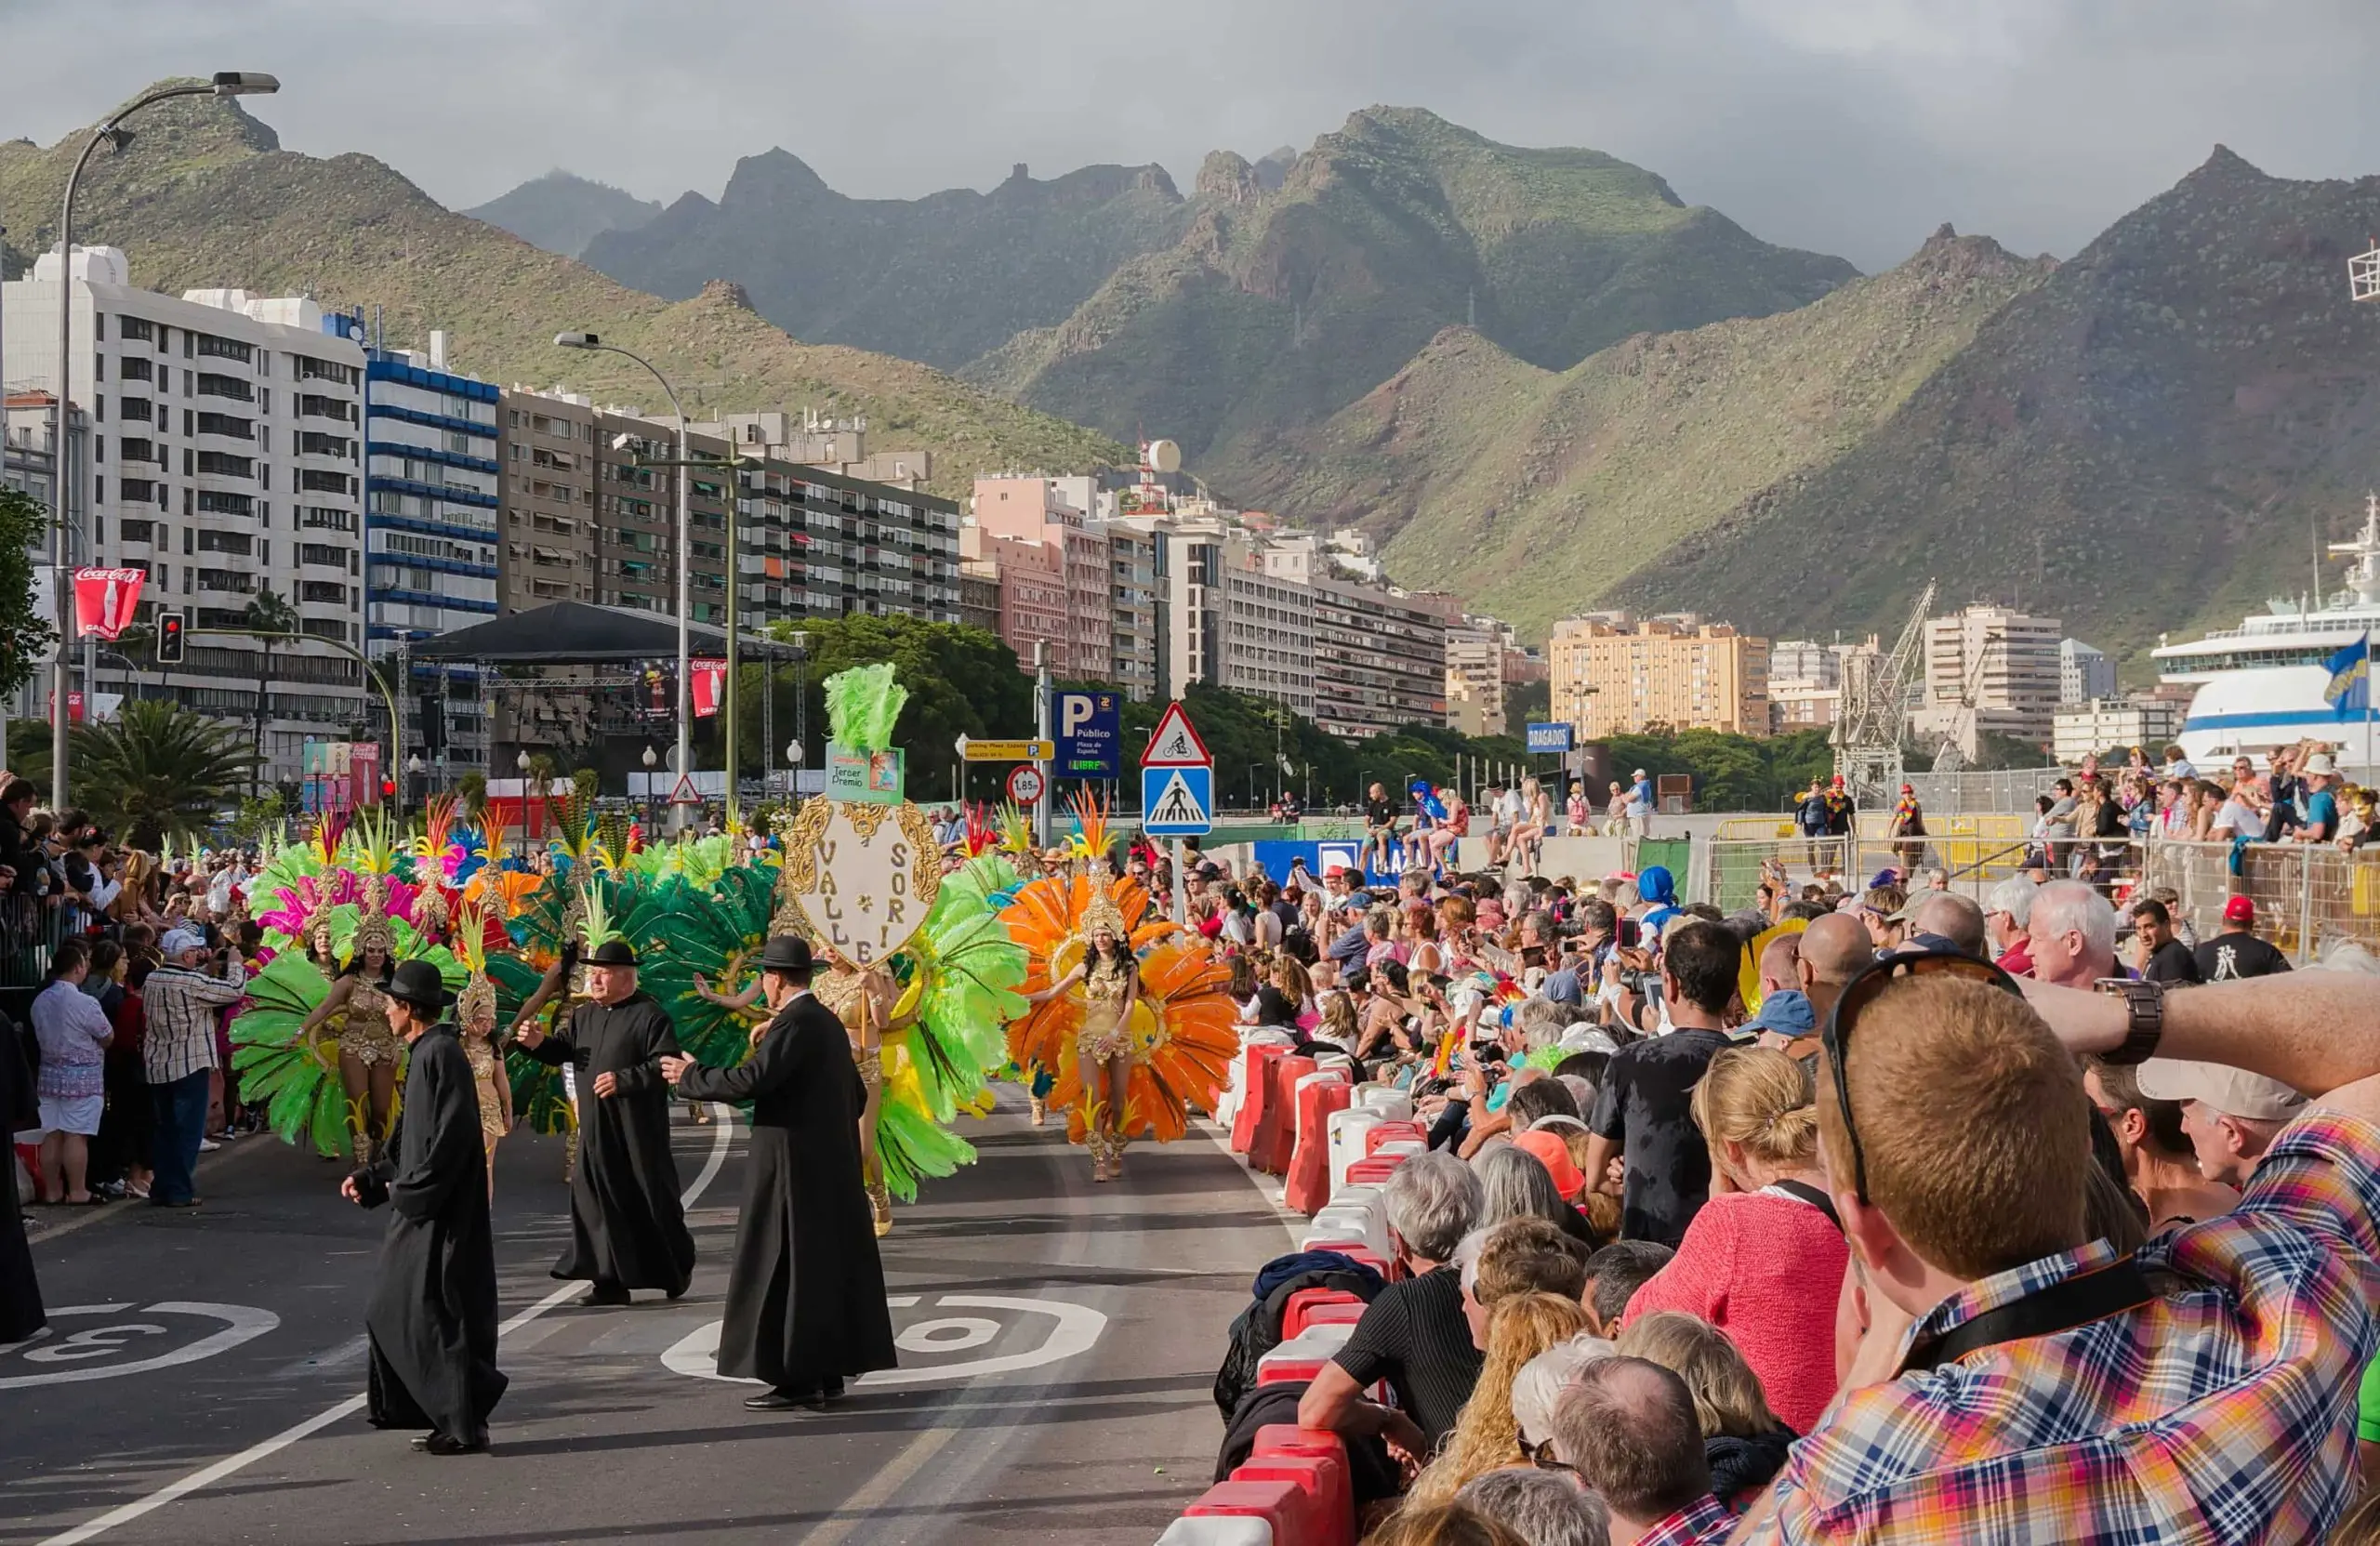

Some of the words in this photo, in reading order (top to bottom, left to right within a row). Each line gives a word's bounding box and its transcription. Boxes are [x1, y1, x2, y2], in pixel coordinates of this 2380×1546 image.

[692, 660, 728, 670] Coca-Col
[1063, 695, 1093, 737] P
[1077, 729, 1111, 738] Público
[1528, 729, 1567, 747] DRAGADOS
[1073, 760, 1101, 770] LIBRE
[833, 766, 862, 777] Tercer
[832, 774, 863, 787] Premio
